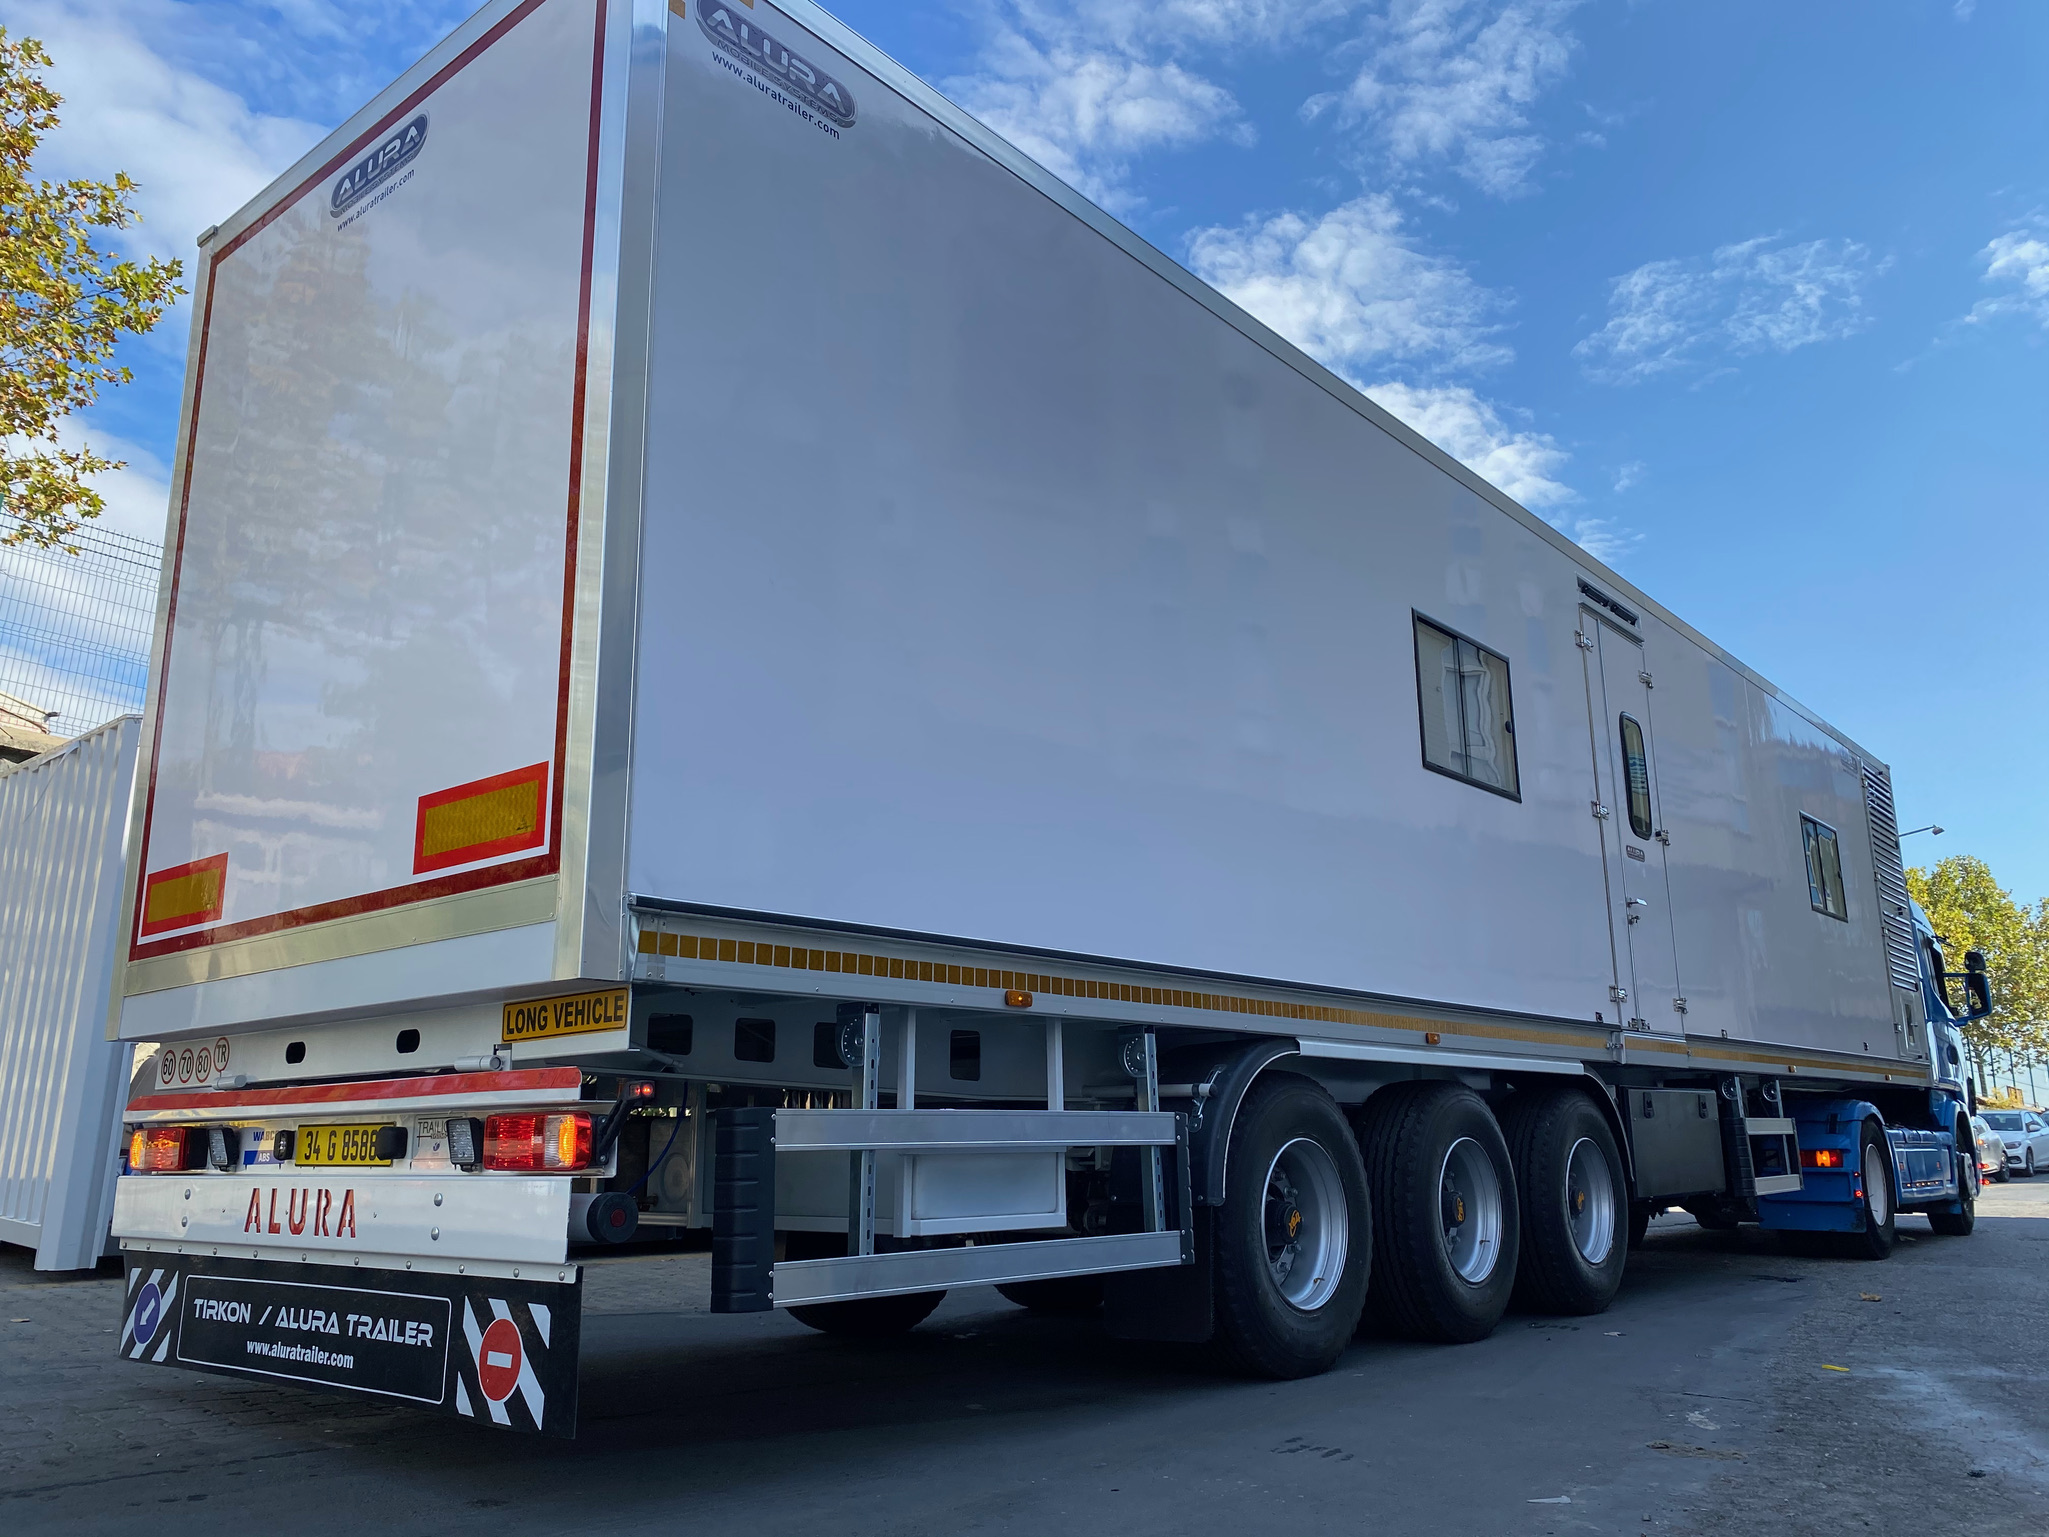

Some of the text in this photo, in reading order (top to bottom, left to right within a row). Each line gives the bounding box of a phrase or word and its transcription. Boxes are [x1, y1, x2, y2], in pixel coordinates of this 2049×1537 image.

[706, 9, 846, 114] ALURA
[717, 40, 839, 123] MOBILE SYSTEMS
[712, 51, 840, 140] www.aluratrailer.com
[336, 126, 420, 206] ALURA
[337, 169, 415, 232] www.aluratrailer.com
[506, 995, 625, 1035] LONG VEHICLE
[163, 1055, 209, 1076] 60 70 80
[216, 1044, 227, 1063] TR
[253, 1130, 279, 1141] WABC
[258, 1152, 270, 1162] ABS
[304, 1130, 320, 1160] 34
[327, 1130, 337, 1161] G
[243, 1187, 356, 1239] ALURA
[193, 1298, 252, 1324] TIRKON
[274, 1306, 340, 1335] ALURA
[345, 1313, 434, 1348] TRAILER
[246, 1340, 354, 1369] www.aluratrailer.com
